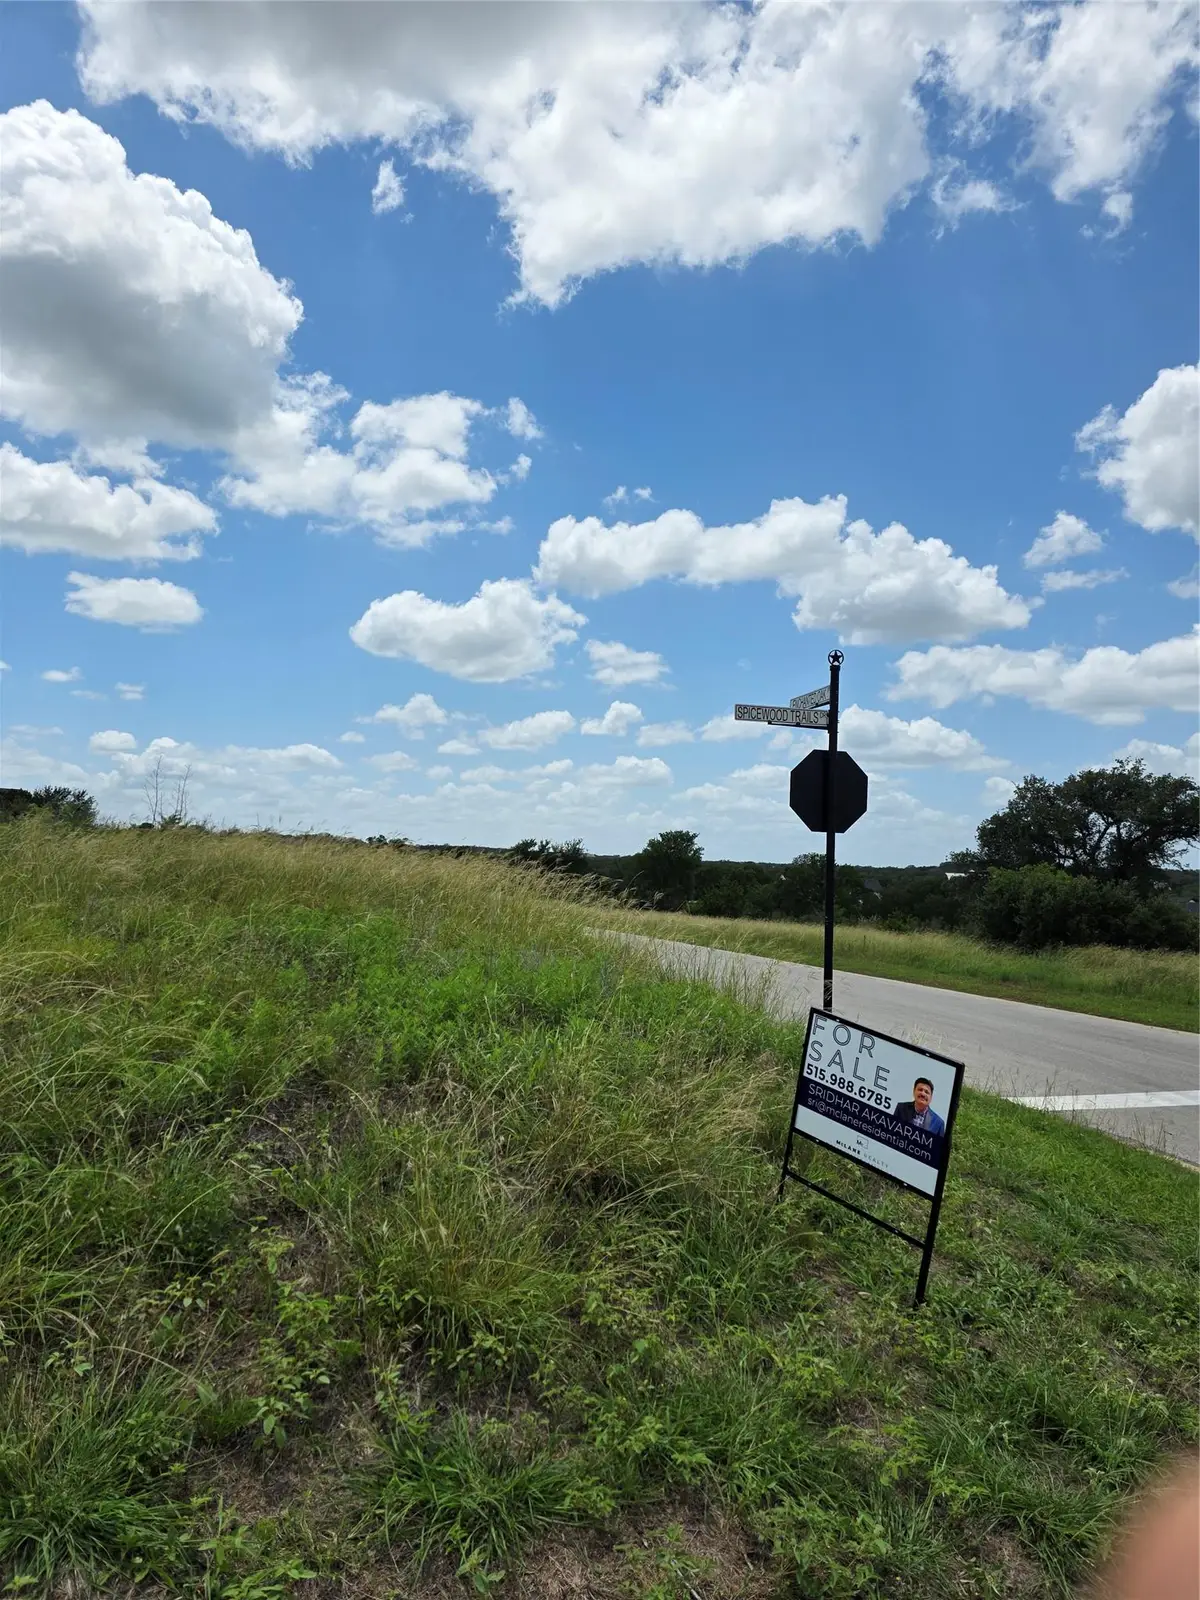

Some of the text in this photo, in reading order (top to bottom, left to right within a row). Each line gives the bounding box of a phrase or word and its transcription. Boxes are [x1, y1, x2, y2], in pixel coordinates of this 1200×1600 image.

[737, 706, 788, 721] SPICEWOOD
[790, 710, 819, 724] TRAILS
[812, 1014, 876, 1058] FOR
[806, 1063, 892, 1110] 515.988.6785
[808, 1040, 890, 1091] SALE
[807, 1097, 931, 1161] sri@mclaneresidential.com
[808, 1083, 933, 1148] SRIDHAR AKAVARAM
